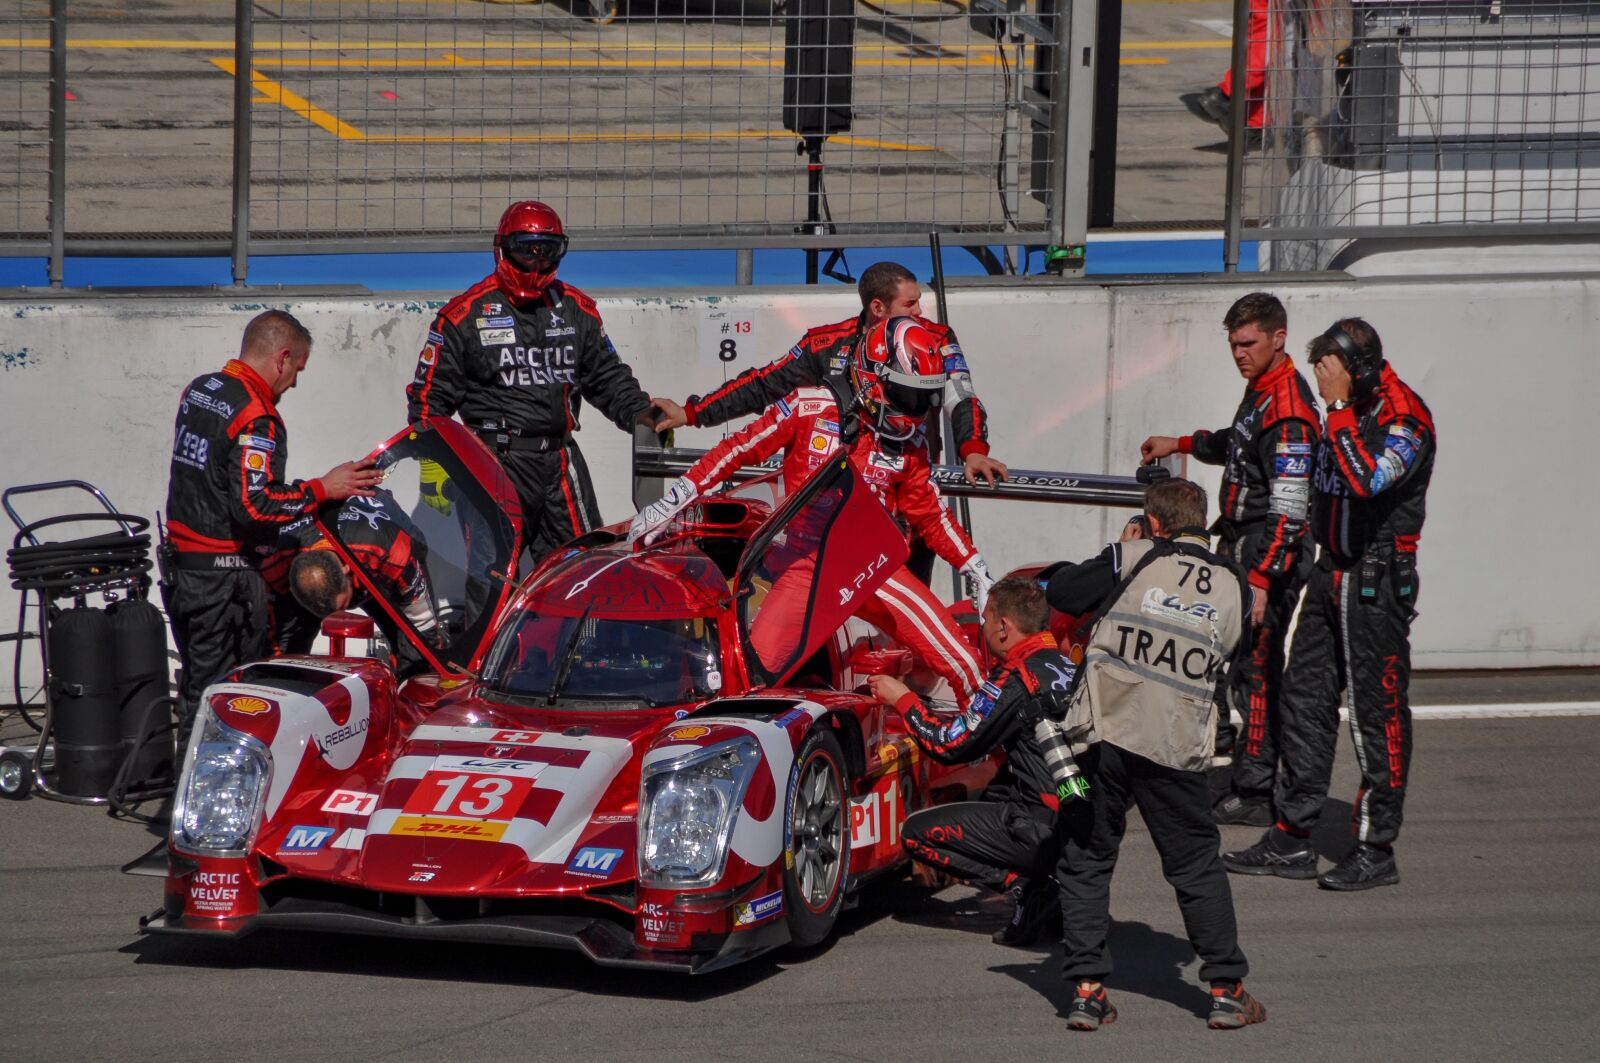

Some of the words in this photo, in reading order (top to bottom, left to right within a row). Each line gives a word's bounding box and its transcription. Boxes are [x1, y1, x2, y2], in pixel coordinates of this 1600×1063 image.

[721, 322, 730, 334] #
[735, 321, 751, 333] 13
[499, 345, 575, 367] ARCTIC
[719, 339, 737, 362] 8
[499, 367, 575, 387] VELVET
[853, 553, 889, 589] PS4
[1177, 560, 1212, 595] 78
[1117, 625, 1222, 685] TRACK
[325, 717, 371, 748] REBELLION
[461, 759, 533, 770] WEC
[328, 793, 373, 812] P1
[433, 775, 513, 816] 13
[416, 823, 486, 836] DHL
[850, 802, 875, 841] P1
[286, 829, 329, 848] M
[575, 851, 617, 871] M
[191, 872, 240, 886] ARCTIC
[563, 870, 608, 880] mouser.com
[190, 886, 239, 901] VELVET
[755, 896, 783, 913] MICHELIN
[642, 918, 685, 932] VELVET
